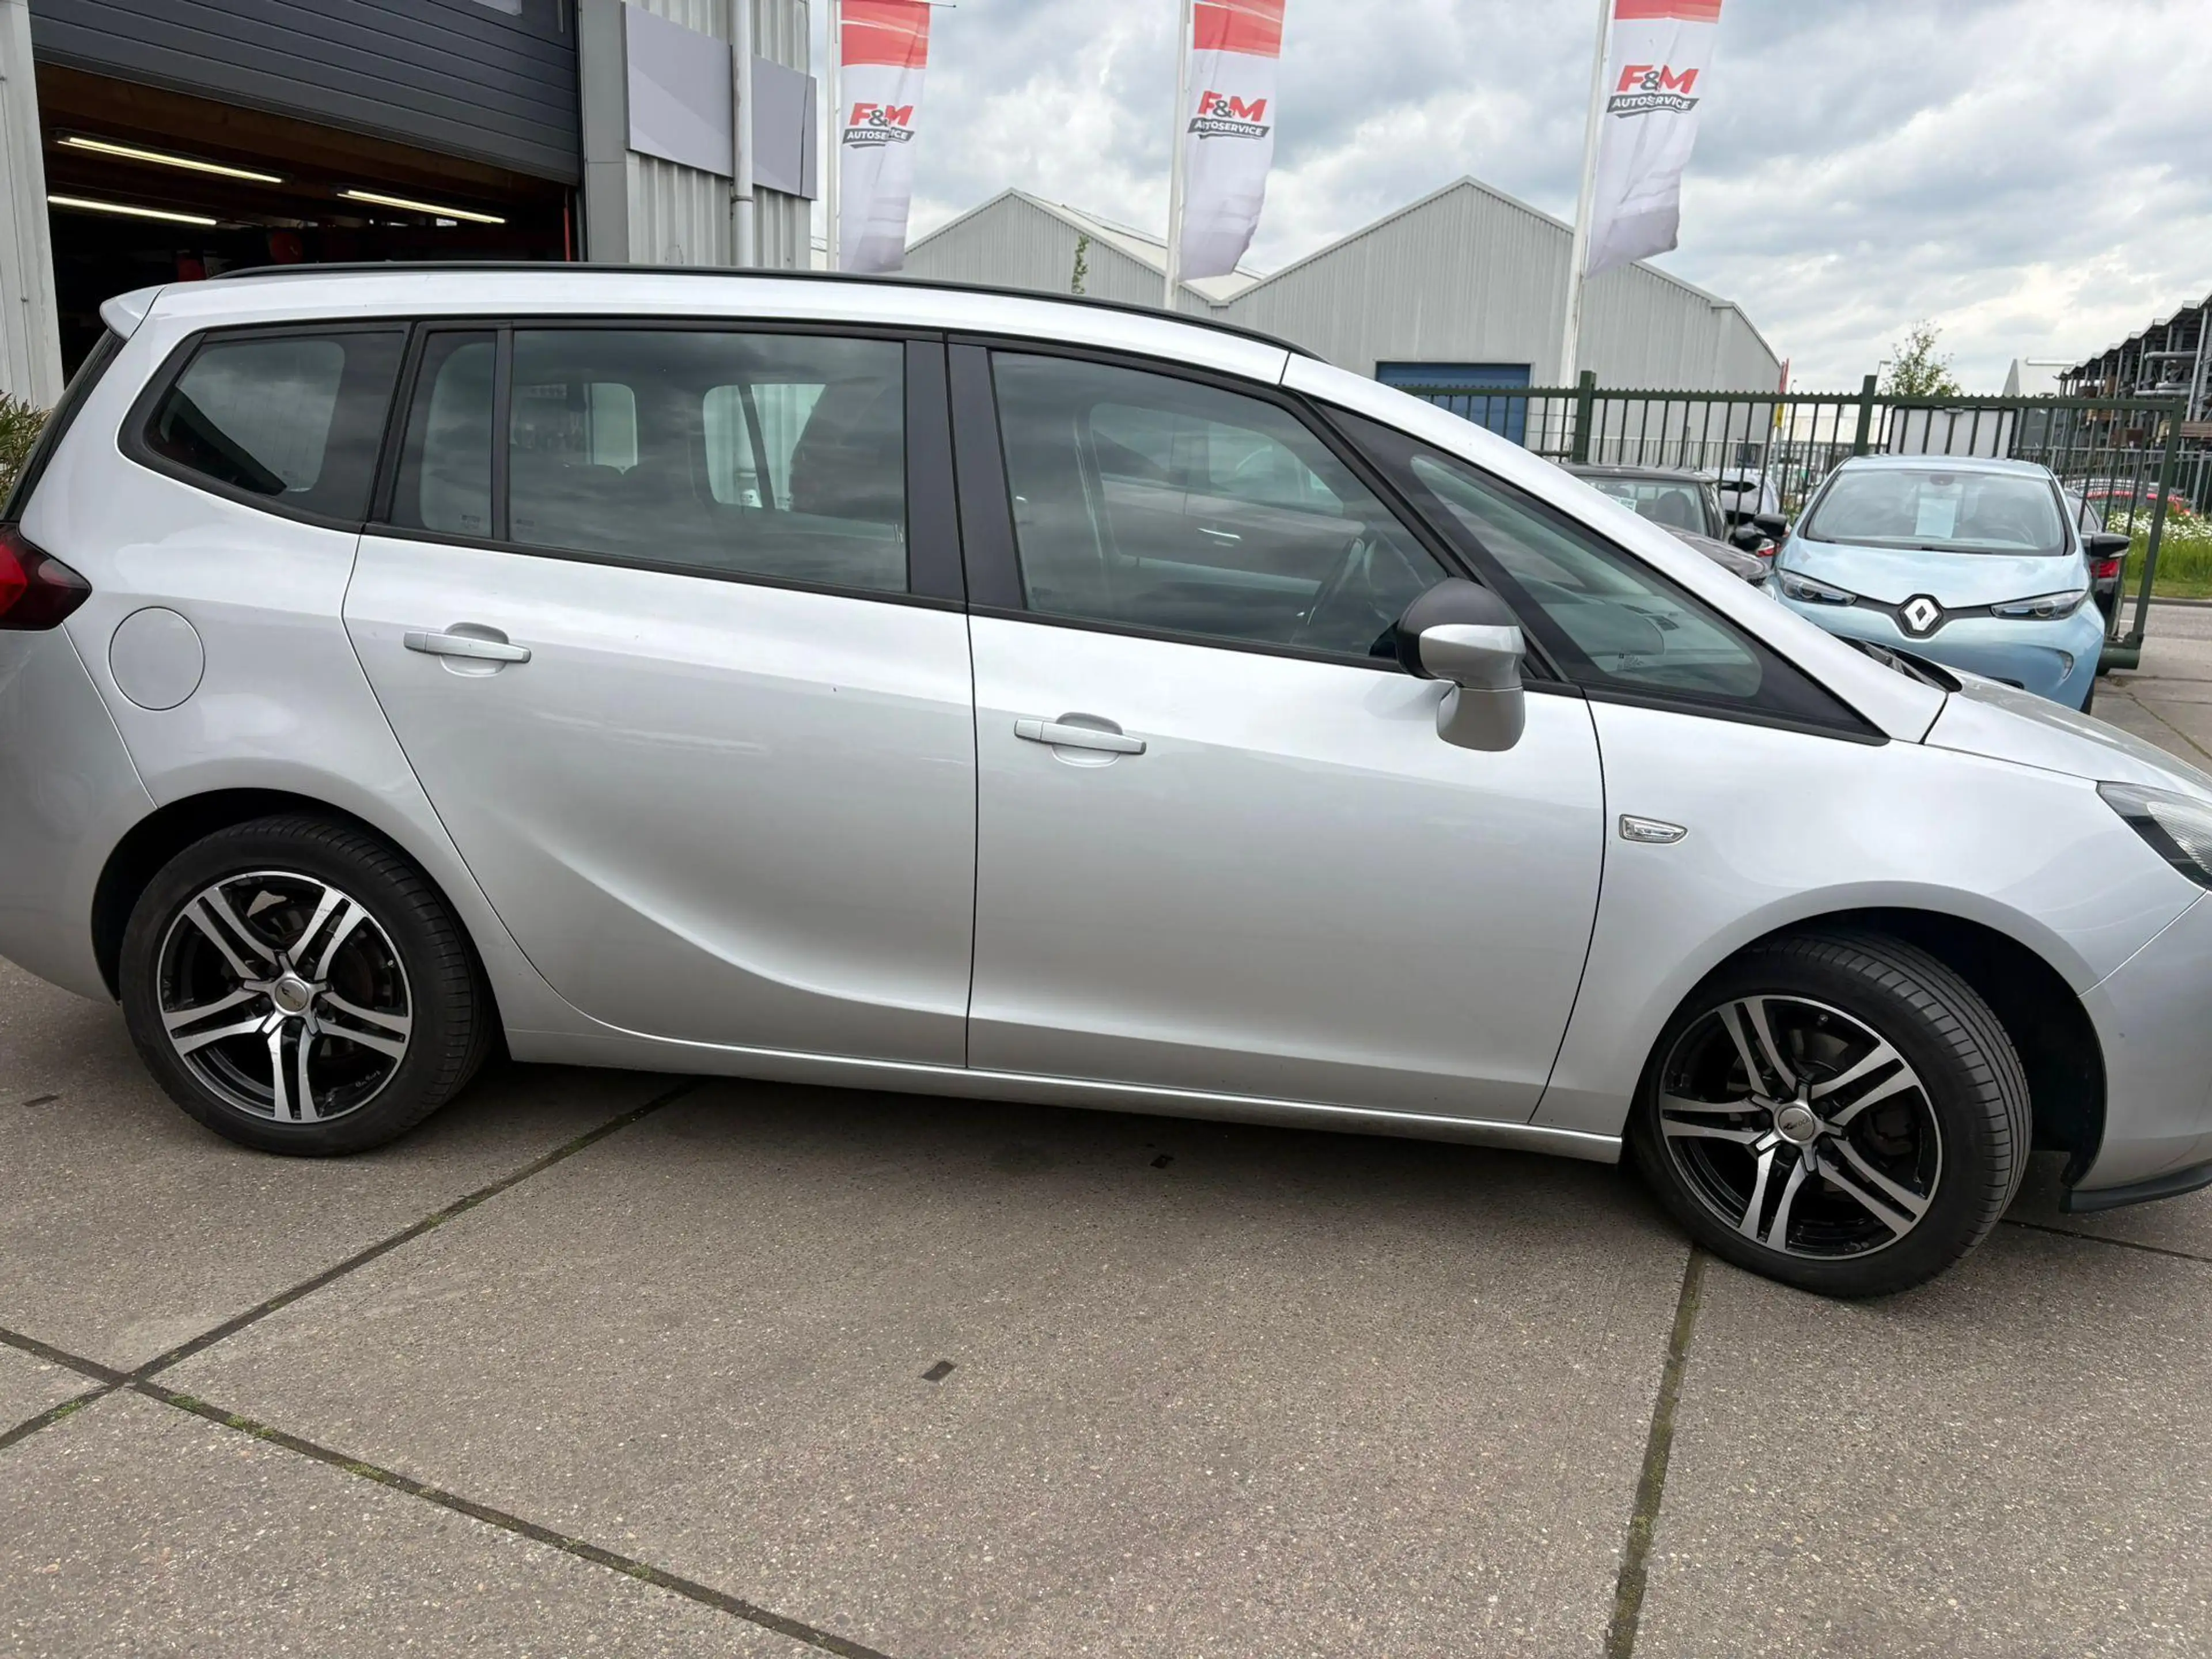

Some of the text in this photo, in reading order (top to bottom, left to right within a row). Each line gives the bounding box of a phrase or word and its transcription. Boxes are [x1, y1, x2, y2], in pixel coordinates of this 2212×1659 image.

[1616, 65, 1699, 94] F&M
[850, 103, 914, 127] F&M
[1198, 90, 1267, 122] F&M
[1612, 95, 1691, 109] AUTOSERVICE
